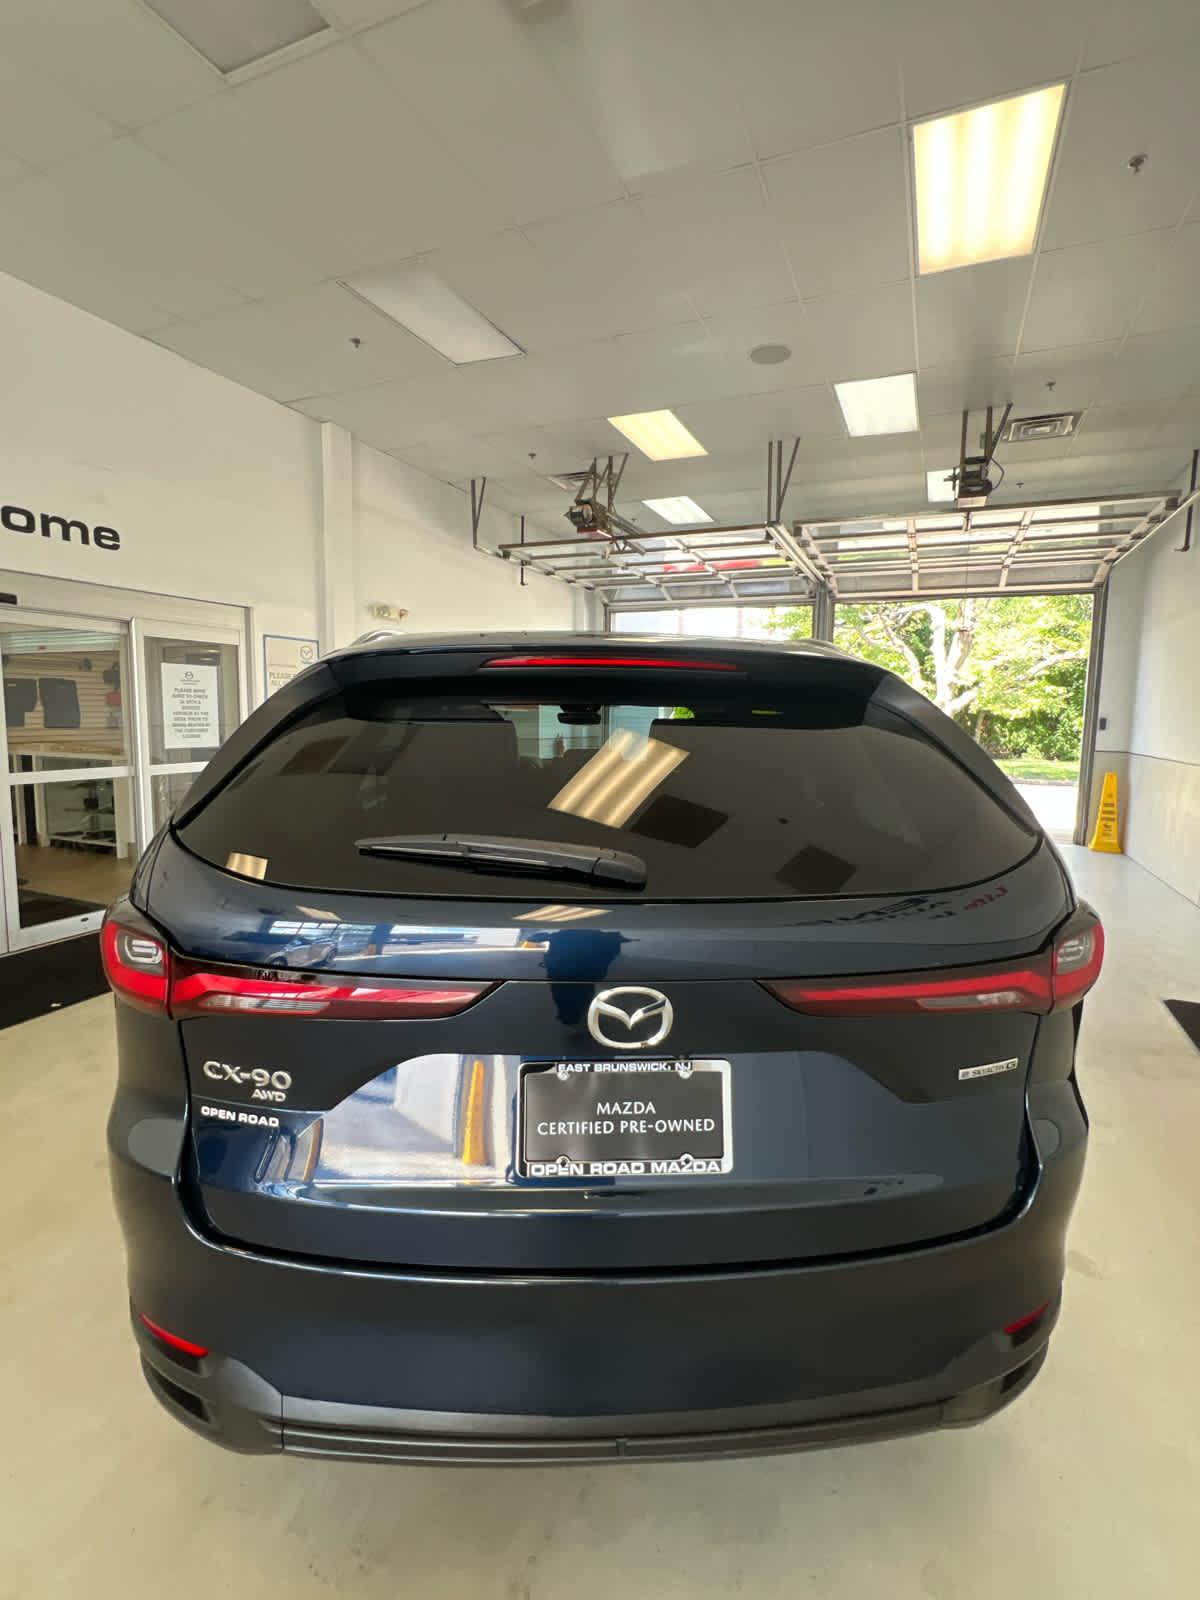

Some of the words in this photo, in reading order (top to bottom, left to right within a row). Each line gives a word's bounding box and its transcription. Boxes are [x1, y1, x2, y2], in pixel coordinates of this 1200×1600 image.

[1, 505, 121, 550] ome
[203, 1060, 292, 1090] CX-90
[558, 1063, 591, 1073] EAST
[674, 1062, 692, 1072] NJ
[251, 1088, 286, 1102] AWD
[201, 1105, 237, 1122] OPEN
[238, 1112, 280, 1128] ROAD
[596, 1101, 657, 1116] MAZDA
[537, 1121, 615, 1136] CERTIFIED
[620, 1118, 716, 1134] PRE-OWNED
[530, 1163, 585, 1176] OPEN
[590, 1162, 646, 1175] ROAD
